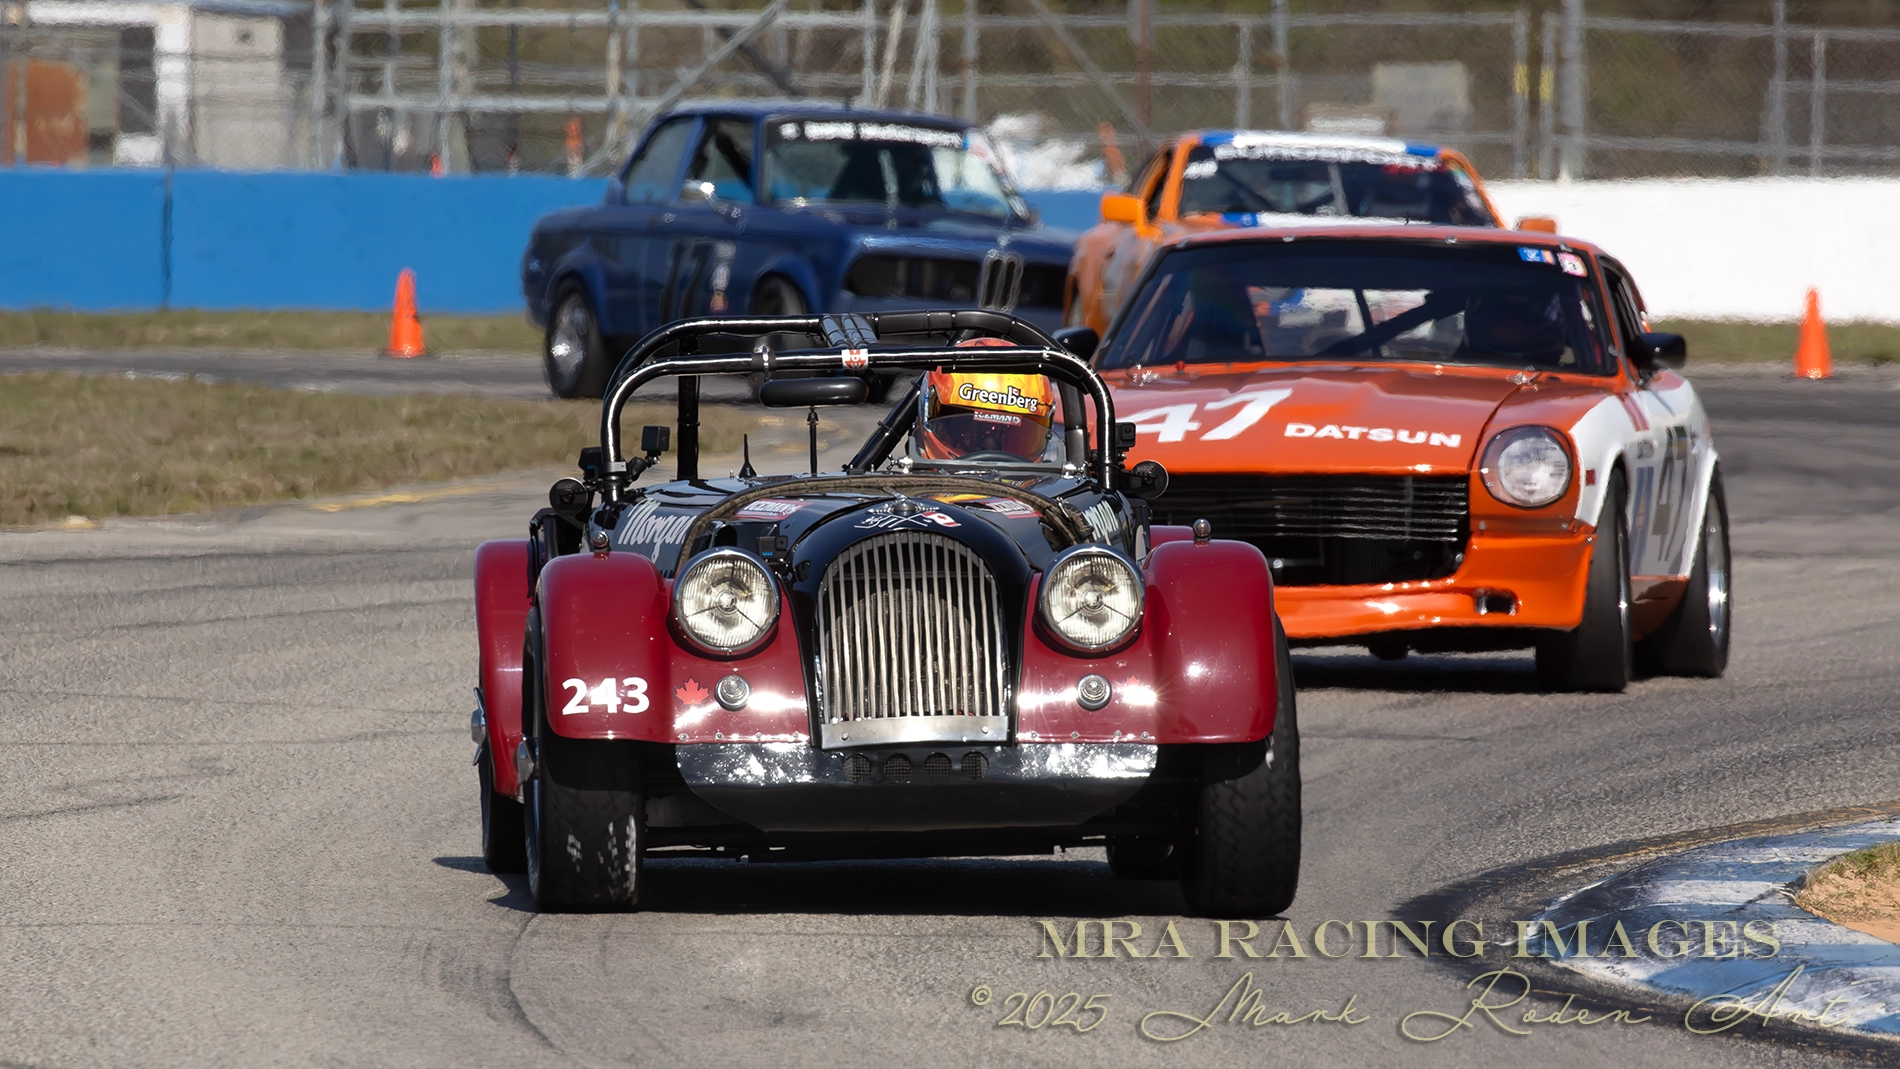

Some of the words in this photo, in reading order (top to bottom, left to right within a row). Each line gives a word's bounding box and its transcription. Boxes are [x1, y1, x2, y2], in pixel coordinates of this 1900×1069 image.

[958, 383, 1039, 412] Greenberg
[1115, 388, 1293, 442] 47
[1284, 423, 1462, 448] DATSUN
[561, 677, 650, 715] 243
